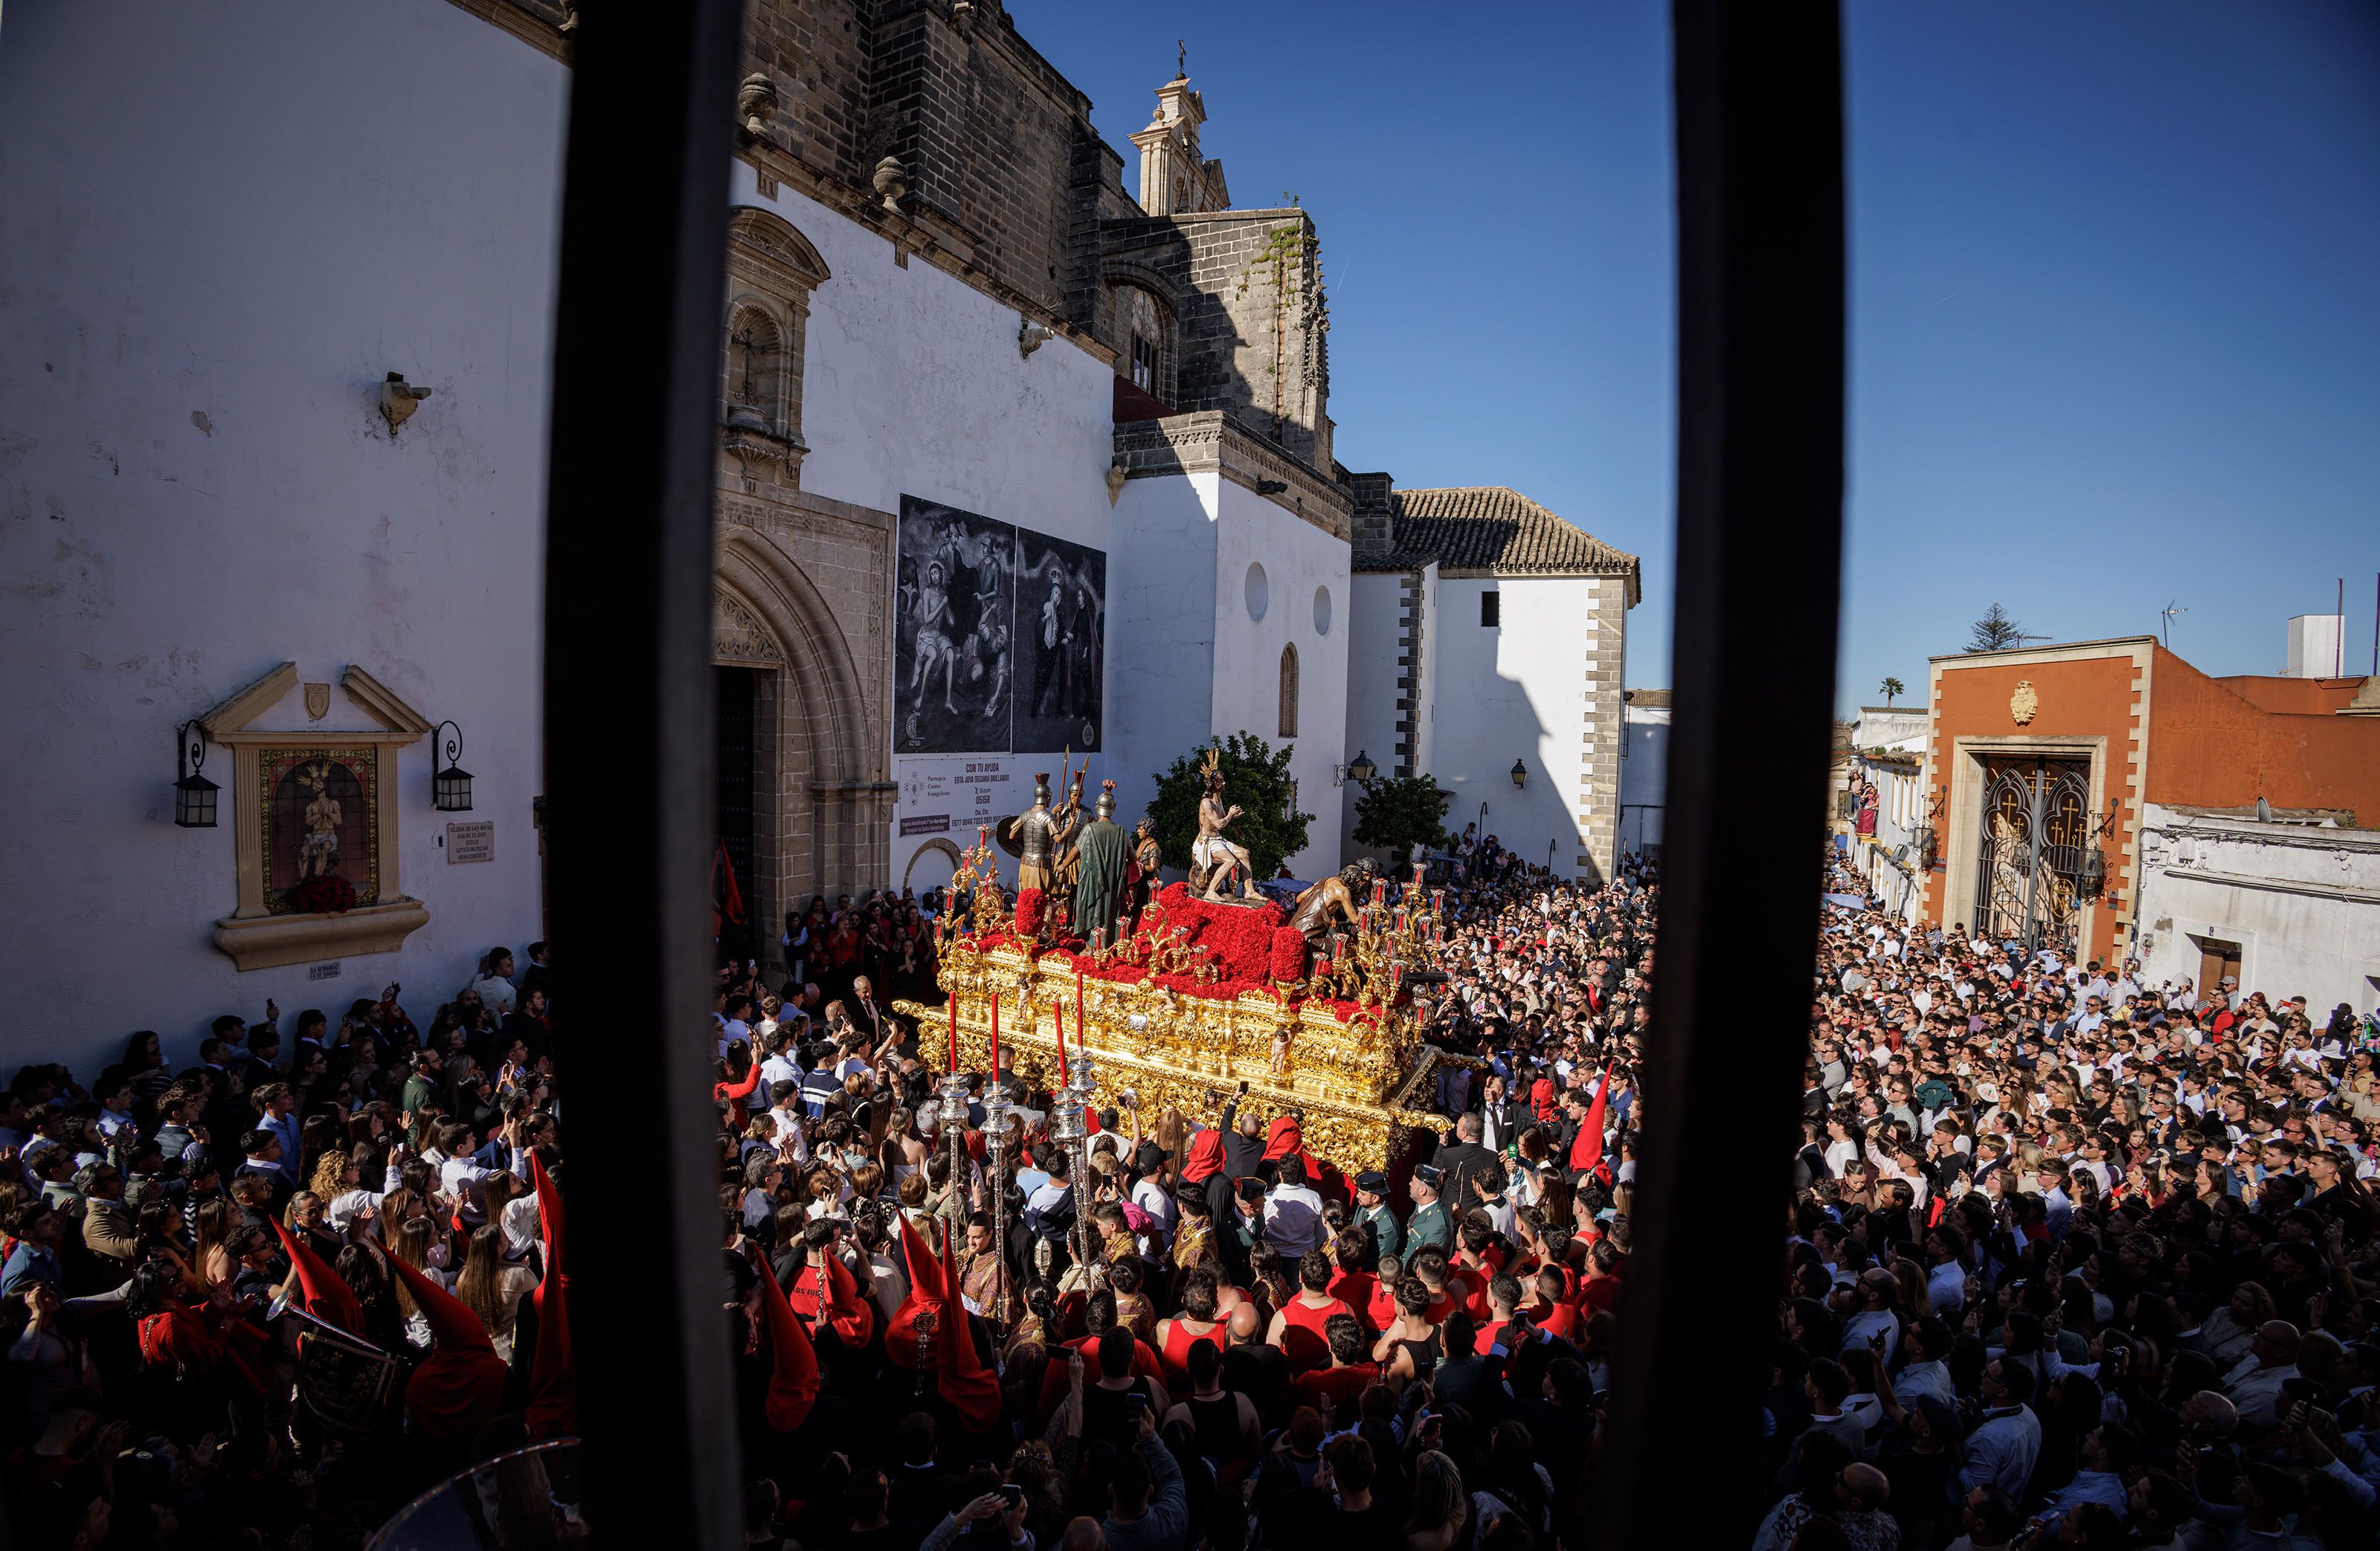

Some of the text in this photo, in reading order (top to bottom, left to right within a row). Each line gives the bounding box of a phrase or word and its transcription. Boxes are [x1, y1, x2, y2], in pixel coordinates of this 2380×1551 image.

[966, 762, 1000, 773] CON TU AYUDA
[974, 774, 990, 783] SEGUIRÁ
[990, 774, 1010, 783] BRILLANDO
[976, 795, 991, 805] 05156
